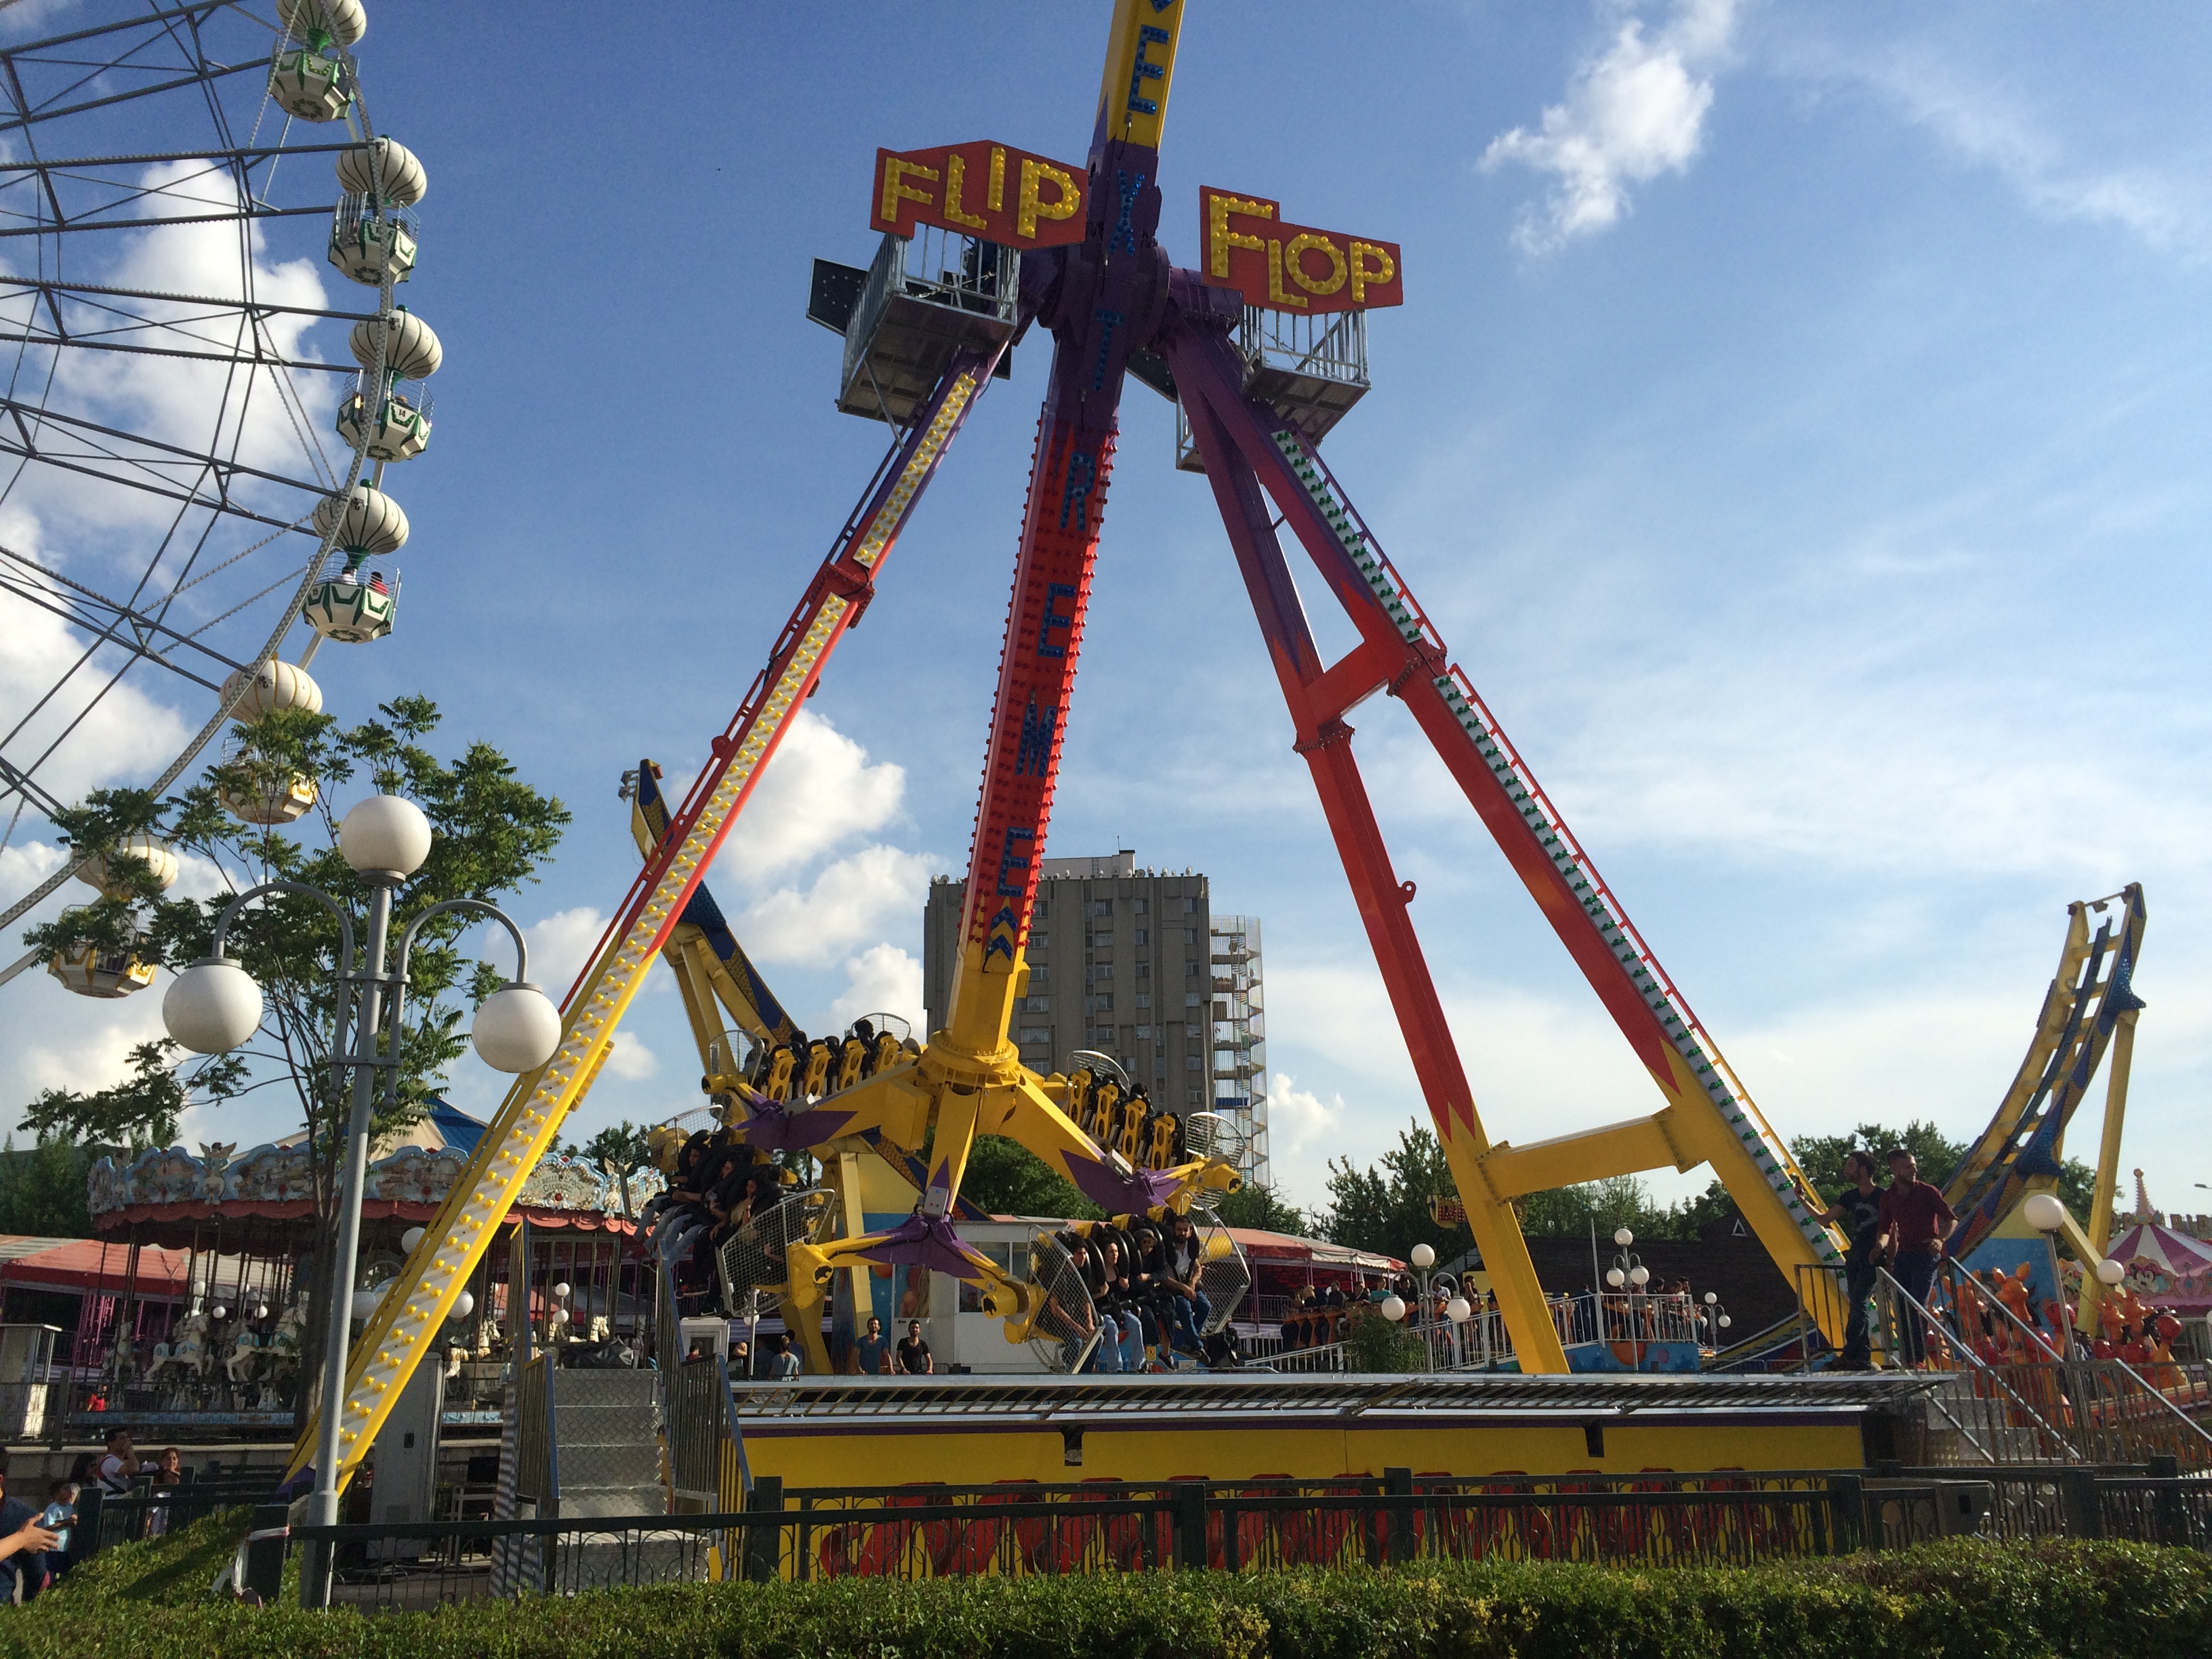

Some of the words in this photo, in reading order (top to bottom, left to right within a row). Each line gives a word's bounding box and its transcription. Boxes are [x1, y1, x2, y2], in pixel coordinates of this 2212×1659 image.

[881, 146, 1081, 239] FLIP
[1209, 194, 1395, 308] FLOP
[398, 409, 406, 417] 14
[996, 24, 1169, 898] EXTREME
